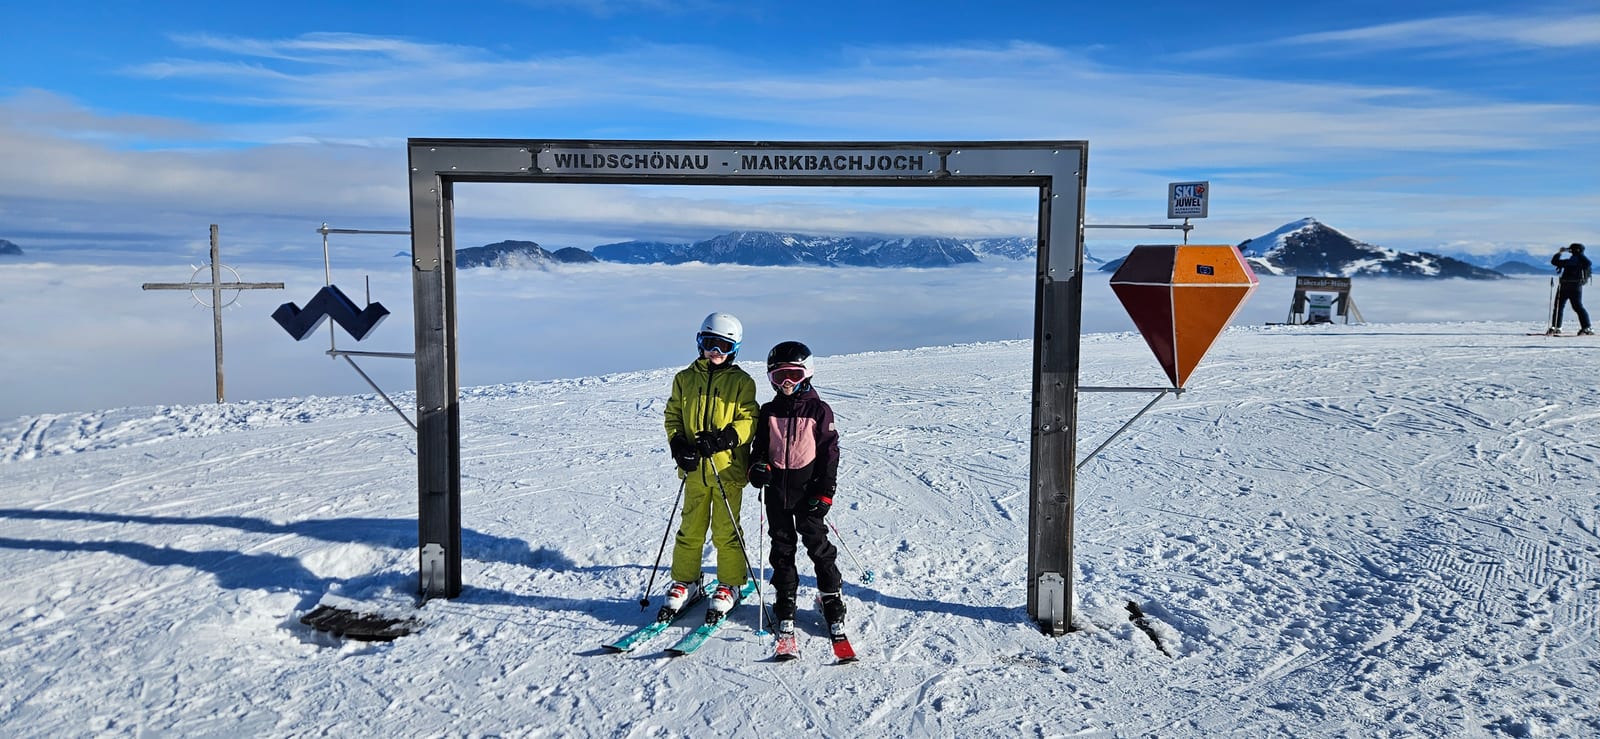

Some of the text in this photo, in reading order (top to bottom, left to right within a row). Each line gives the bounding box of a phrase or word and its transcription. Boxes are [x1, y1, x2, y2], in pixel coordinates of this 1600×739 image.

[554, 151, 709, 170] WILDSCHÖNAU
[741, 155, 923, 171] MARKBACHJOCH
[1175, 185, 1194, 199] SKI
[1175, 197, 1201, 207] JUWEL
